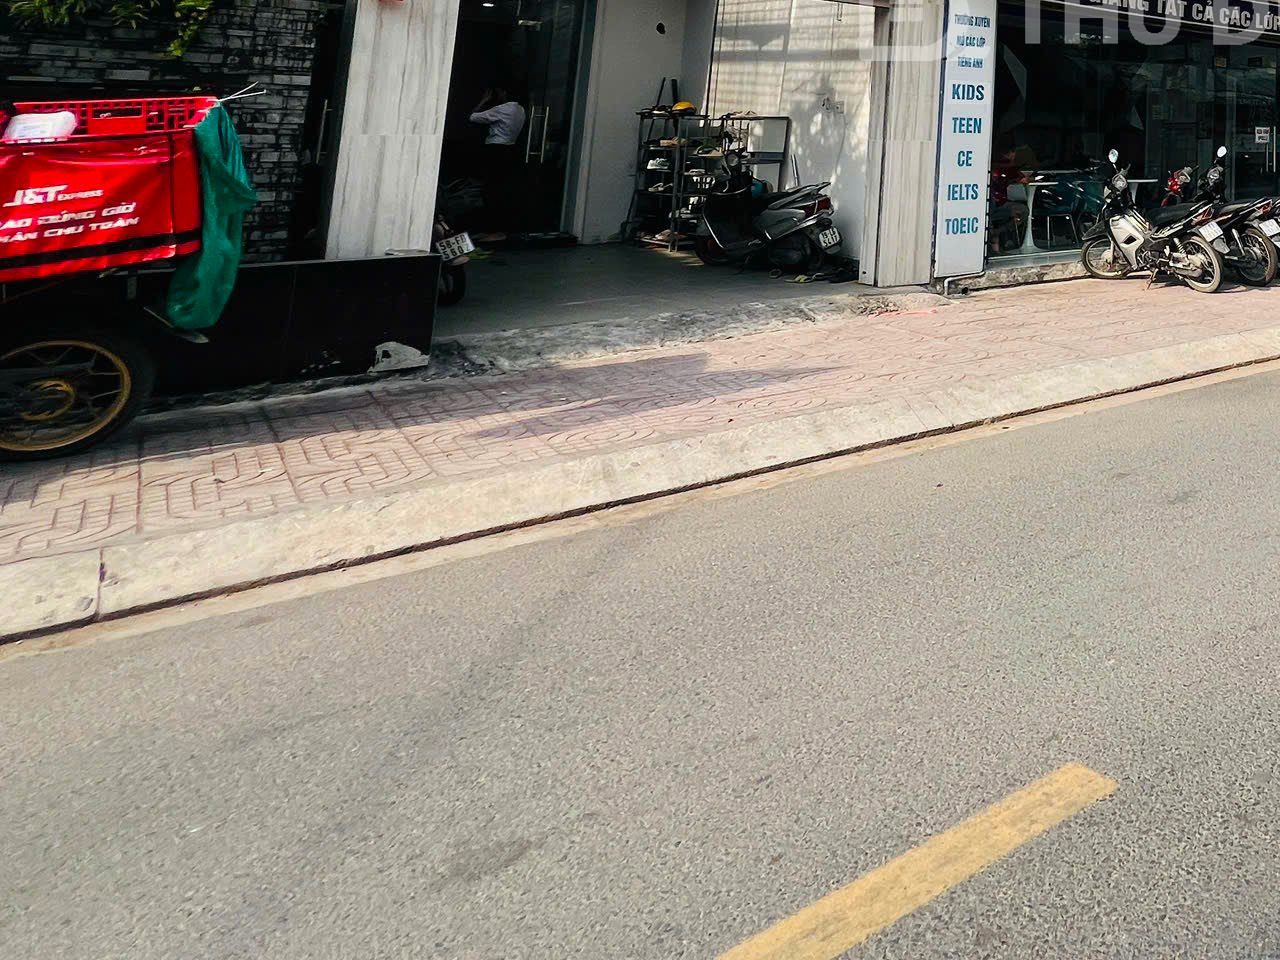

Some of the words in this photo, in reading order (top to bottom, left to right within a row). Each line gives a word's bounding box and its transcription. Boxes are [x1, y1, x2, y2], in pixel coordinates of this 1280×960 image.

[1191, 0, 1215, 23] CẢ
[1219, 6, 1251, 28] CÁC
[951, 83, 985, 102] KIDS
[951, 117, 982, 134] TEEN
[957, 150, 973, 167] CE
[3, 185, 68, 208] J&T
[947, 183, 979, 202] IELTS
[44, 225, 85, 238] CHU
[945, 216, 979, 236] TOEIC
